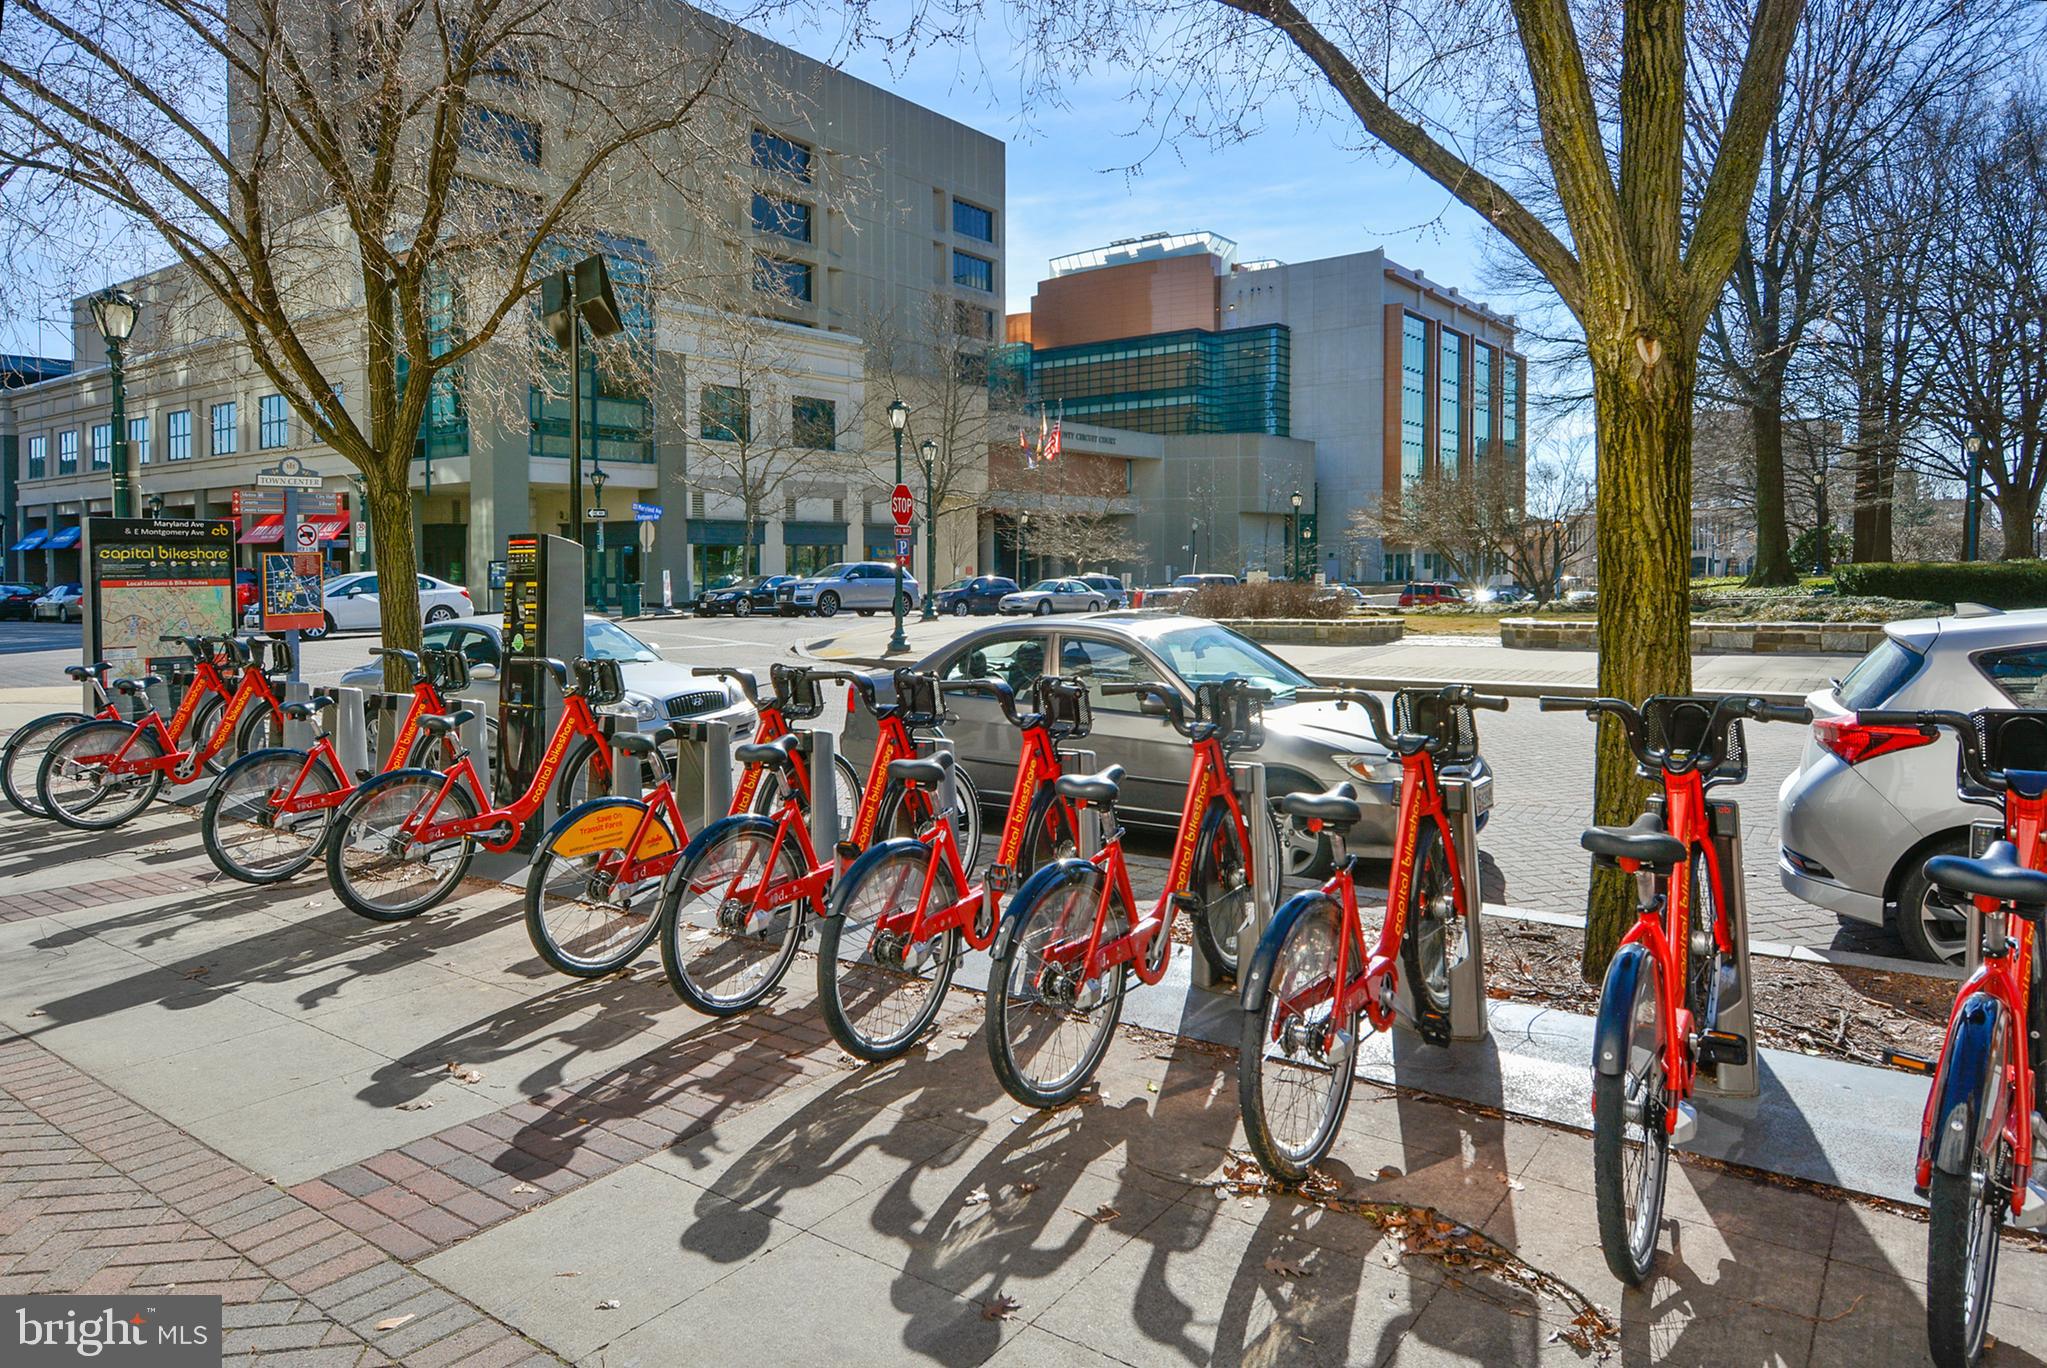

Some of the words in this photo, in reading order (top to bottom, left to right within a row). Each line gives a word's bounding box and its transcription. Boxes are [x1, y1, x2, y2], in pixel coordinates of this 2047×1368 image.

[141, 528, 189, 537] Montgomery
[154, 520, 189, 529] Maryland
[892, 497, 912, 513] STOP
[99, 547, 154, 562] capital
[158, 545, 228, 560] bikeshare
[213, 722, 232, 750] capital
[227, 686, 252, 722] bikeshare
[532, 766, 553, 803] capital
[546, 717, 575, 765] bikeshare
[867, 744, 893, 802] bikeshare
[597, 815, 611, 823] Save
[1012, 759, 1037, 823] bikeshare
[1184, 772, 1210, 842] bikeshare
[580, 823, 603, 835] Transit
[1401, 789, 1421, 867] bikeshare
[1394, 872, 1409, 936] capital
